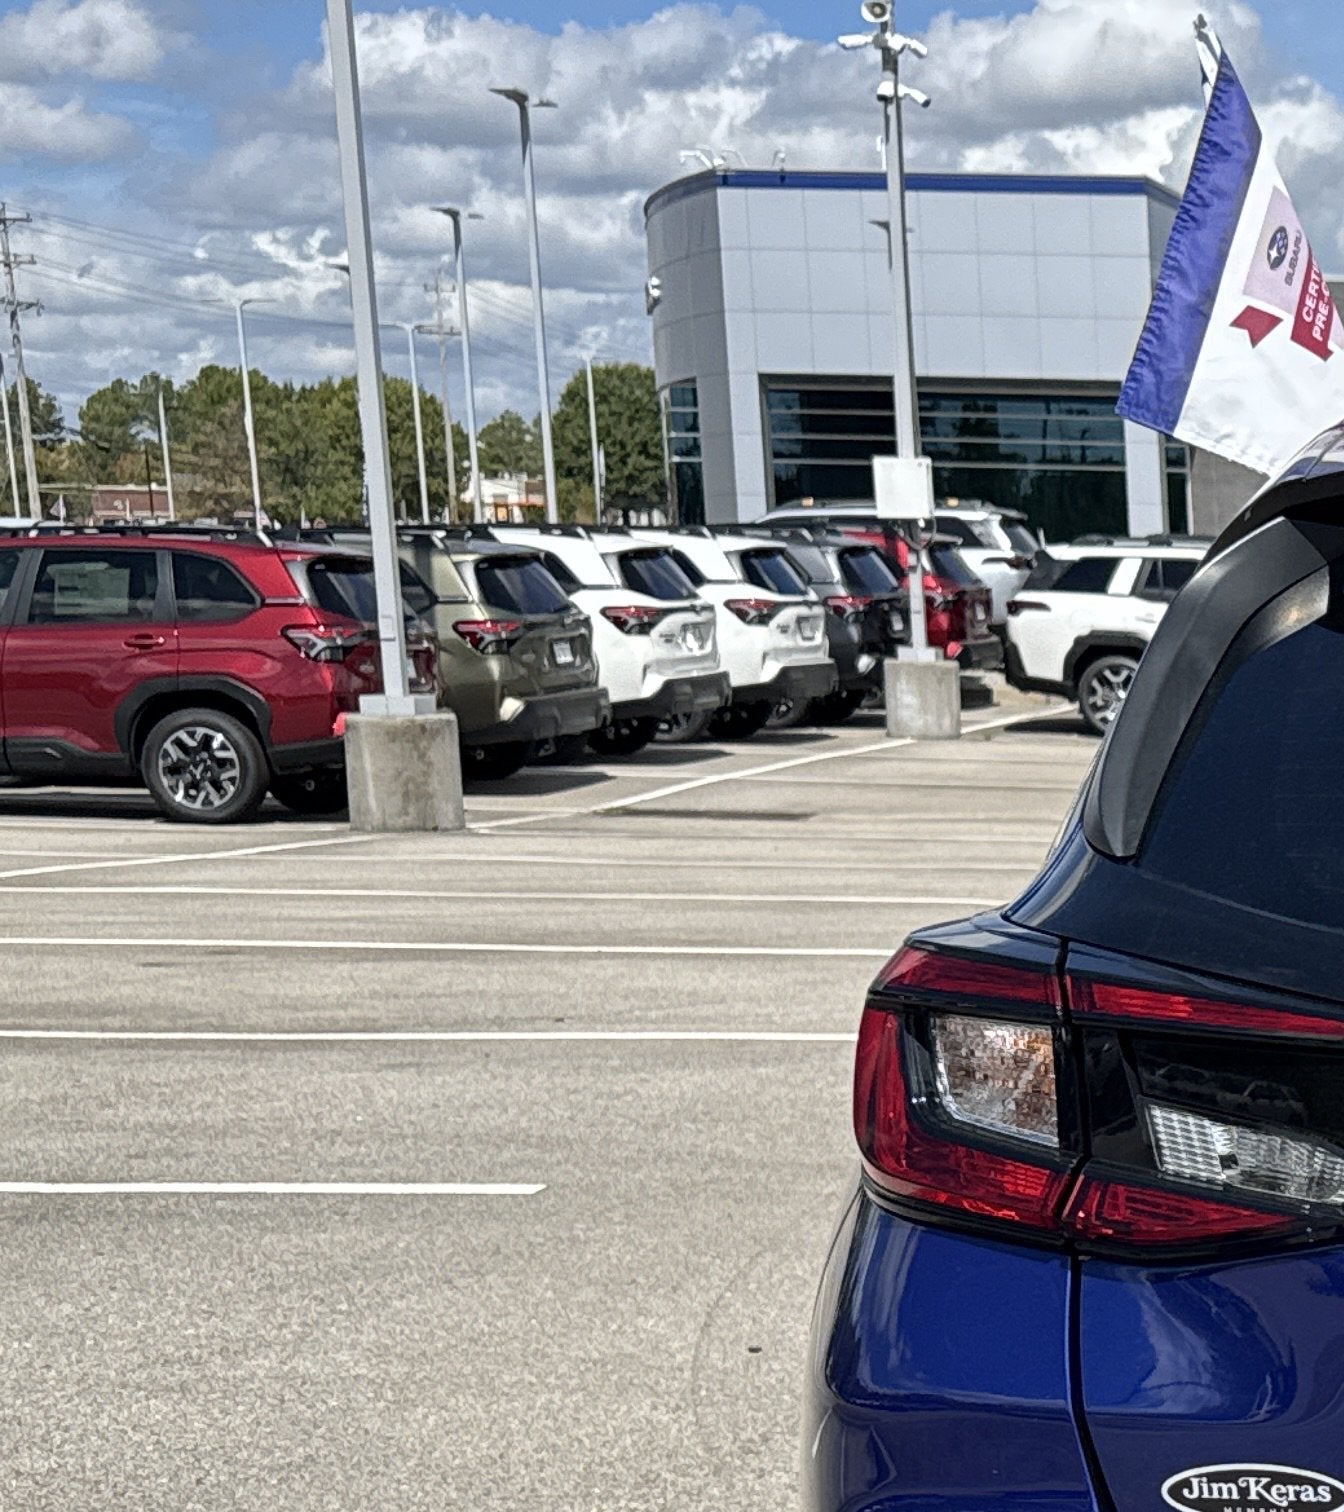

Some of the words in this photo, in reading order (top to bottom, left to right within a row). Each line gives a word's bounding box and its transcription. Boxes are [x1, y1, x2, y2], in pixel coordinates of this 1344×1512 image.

[1284, 229, 1302, 287] SUBARU
[1182, 1476, 1241, 1500] Jim
[1238, 1476, 1332, 1508] Keras
